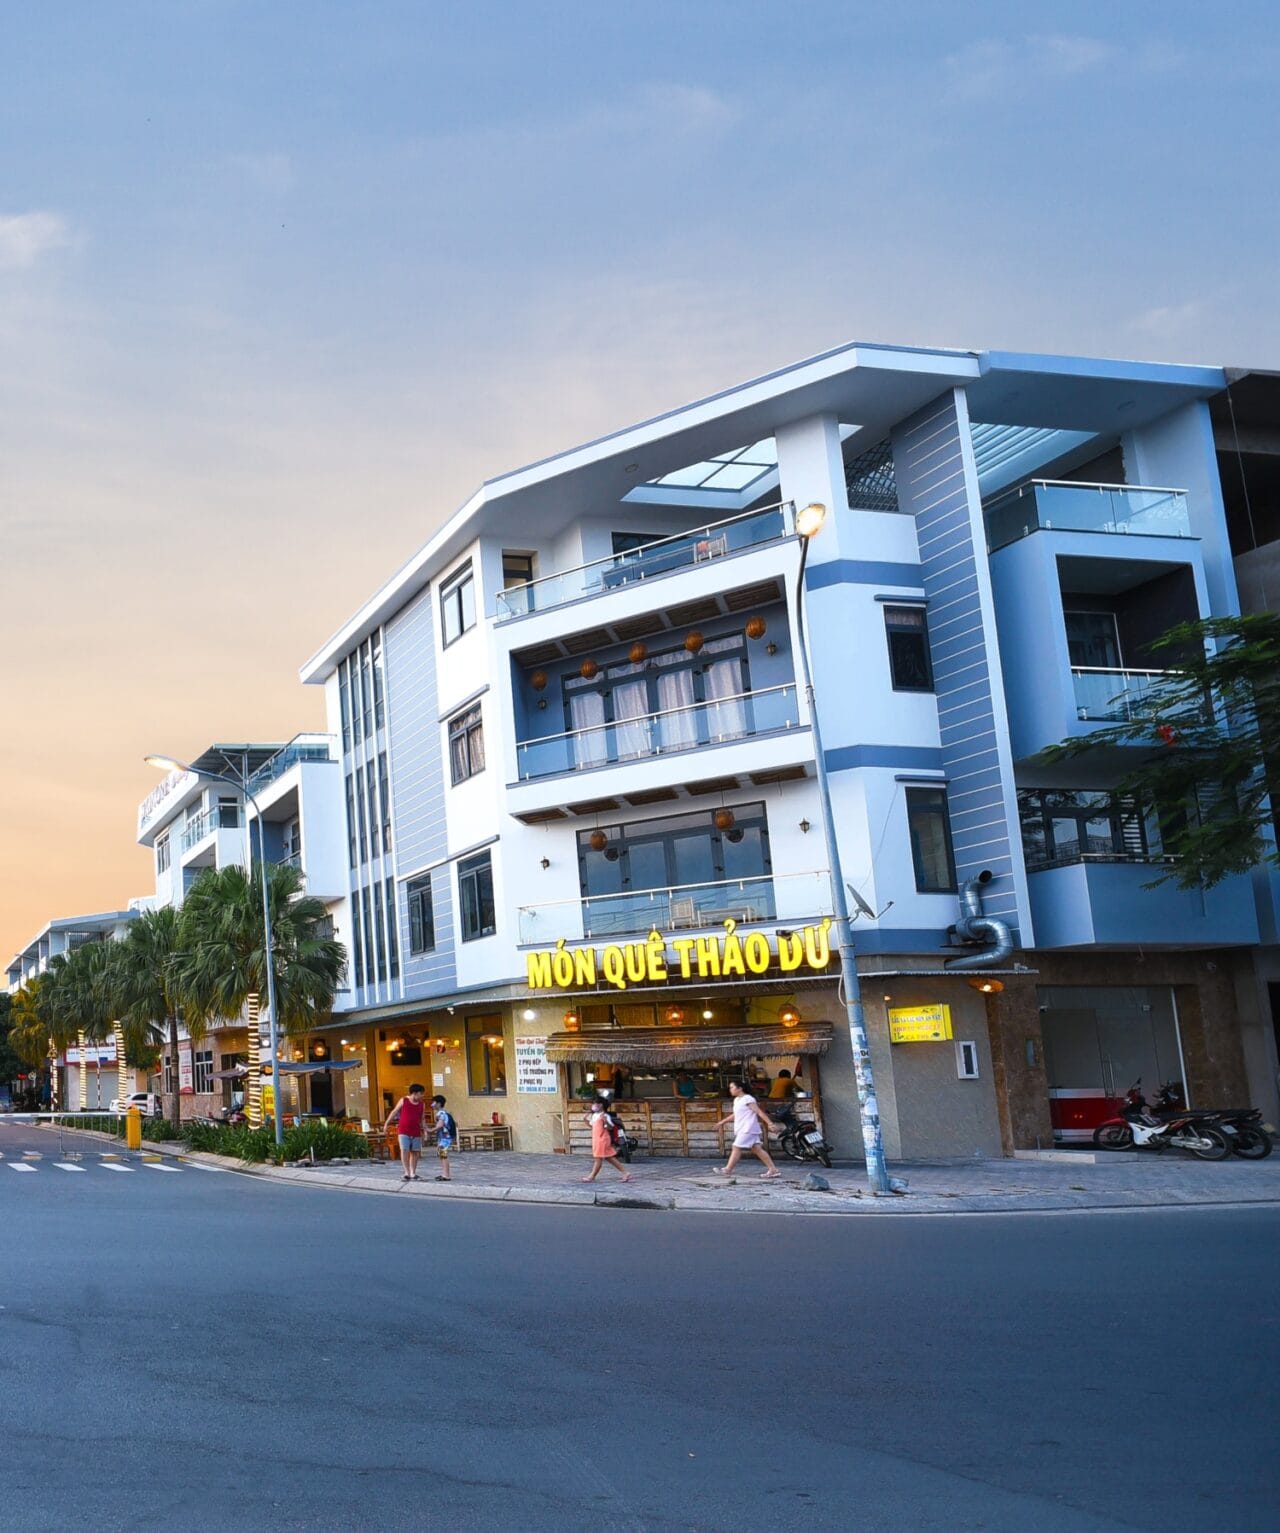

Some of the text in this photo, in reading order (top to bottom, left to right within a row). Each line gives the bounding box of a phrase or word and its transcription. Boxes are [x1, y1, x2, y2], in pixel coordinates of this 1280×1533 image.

[526, 938, 596, 989] MÓN
[602, 929, 669, 990] QUÊ
[673, 918, 770, 979] THẢO
